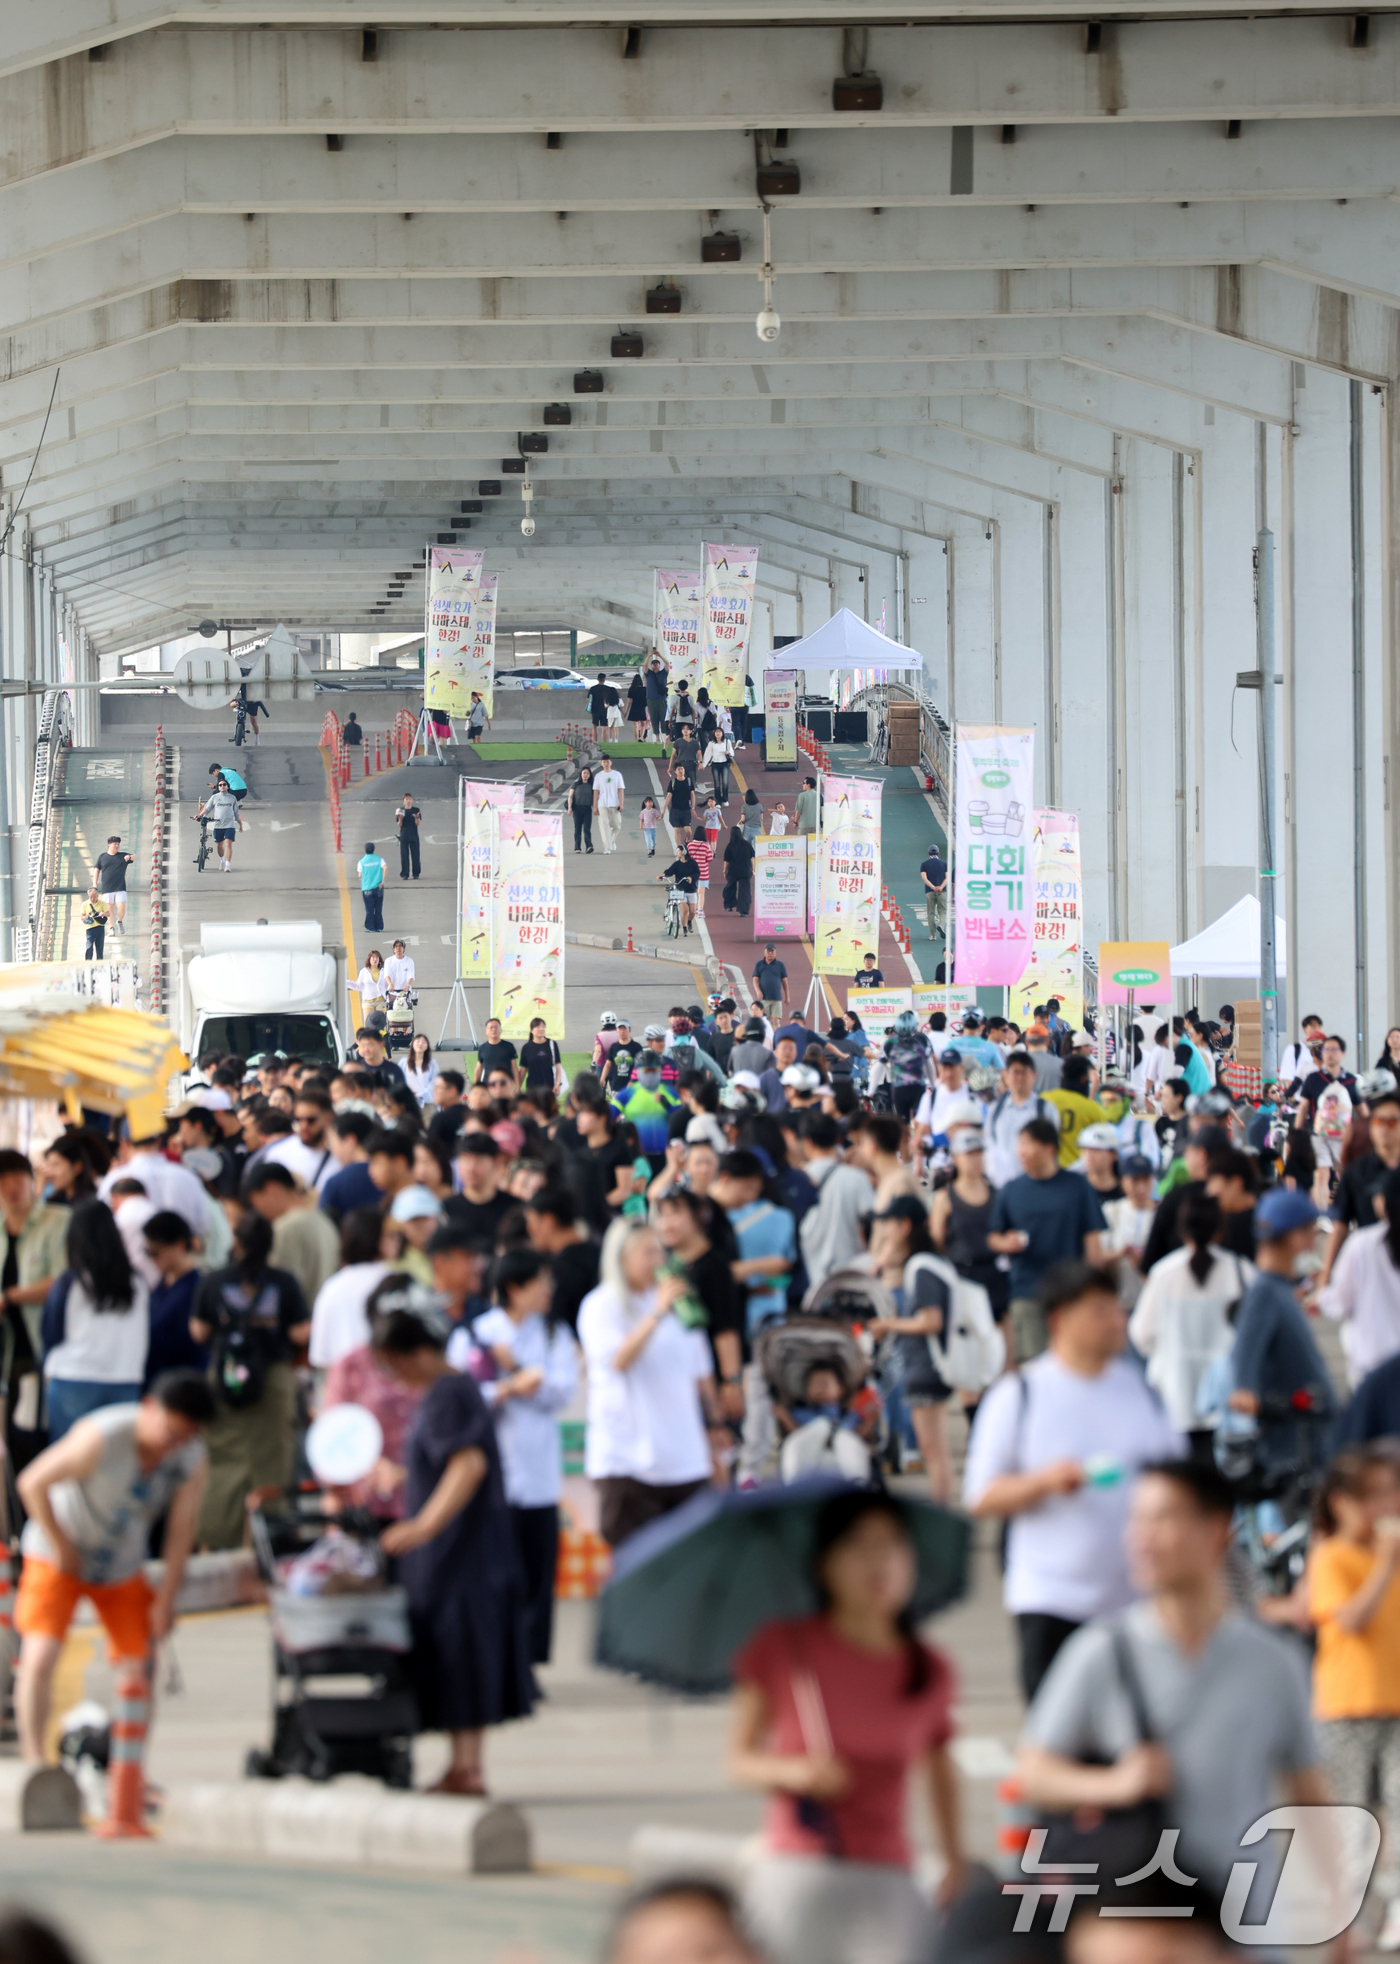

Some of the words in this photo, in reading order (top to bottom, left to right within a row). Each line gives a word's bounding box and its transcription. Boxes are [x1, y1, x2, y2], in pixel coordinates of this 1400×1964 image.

[433, 600, 452, 613] 선셋
[453, 601, 472, 614] 요가
[709, 597, 727, 610] 선셋
[729, 598, 747, 611] 요가
[432, 614, 471, 629] 나마스테,
[663, 618, 679, 630] 선셋
[682, 619, 698, 631] 요가
[710, 611, 747, 626] 나마스테,
[476, 621, 492, 632] 요가
[715, 625, 736, 639] 한강!
[439, 628, 460, 642] 한강!
[474, 633, 493, 645] 스테,
[663, 631, 699, 644] 나마스테,
[473, 645, 484, 659] 강!
[669, 644, 689, 656] 한강!
[768, 842, 794, 850] 다회용기
[830, 841, 850, 857] 선셋
[853, 843, 874, 859] 요가
[967, 844, 1025, 875] 다회
[829, 858, 876, 877] 나마스테,
[838, 876, 864, 893] 한강!
[1036, 882, 1049, 899] 셋
[1052, 882, 1078, 899] 요가
[508, 885, 534, 903] 선셋
[538, 886, 561, 904] 요가
[966, 880, 1023, 911] 용기
[508, 905, 563, 925] 나마스테,
[1036, 902, 1080, 921] 마스테,
[519, 926, 549, 944] 한강!
[964, 917, 1027, 941] 반납소
[1034, 922, 1066, 941] 한강!
[864, 1005, 895, 1014] 주행금지
